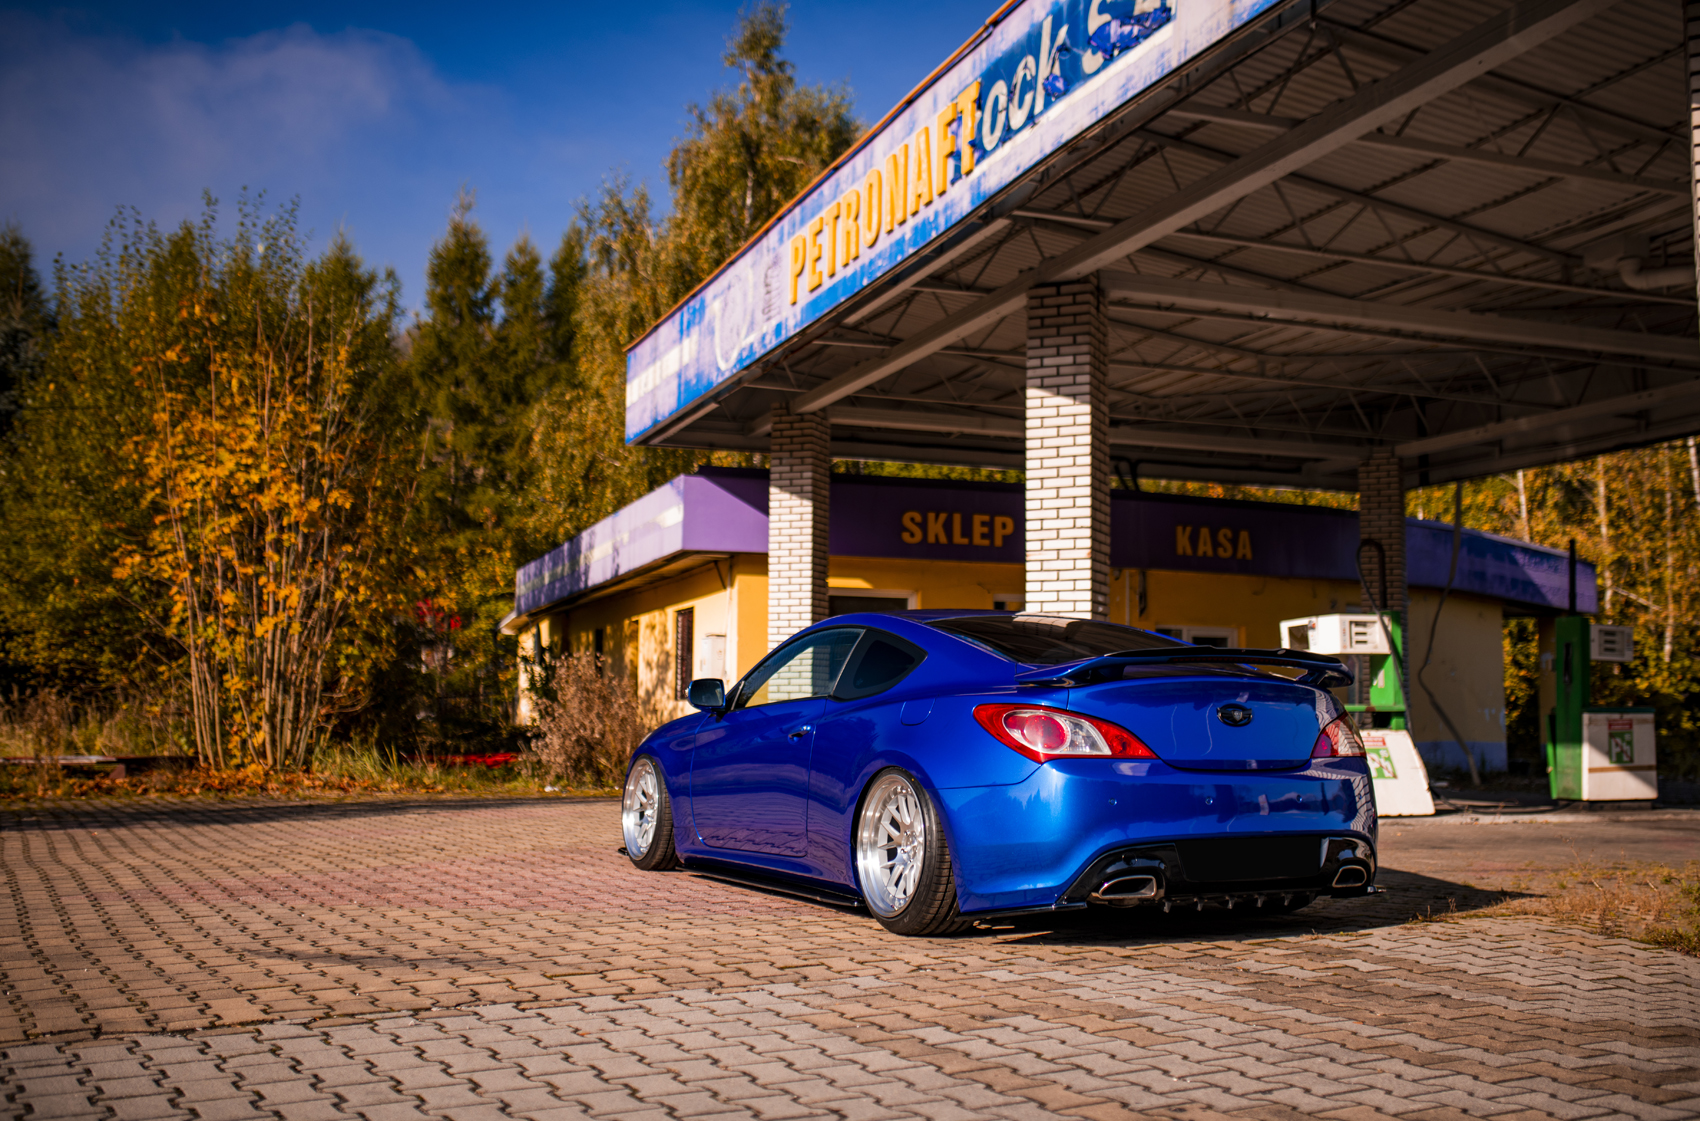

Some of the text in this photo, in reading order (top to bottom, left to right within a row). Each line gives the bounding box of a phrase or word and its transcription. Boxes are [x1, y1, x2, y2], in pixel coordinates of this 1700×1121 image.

[789, 80, 981, 306] PETRONAFT
[901, 510, 1015, 548] SKLEP
[1175, 525, 1254, 561] KASA
